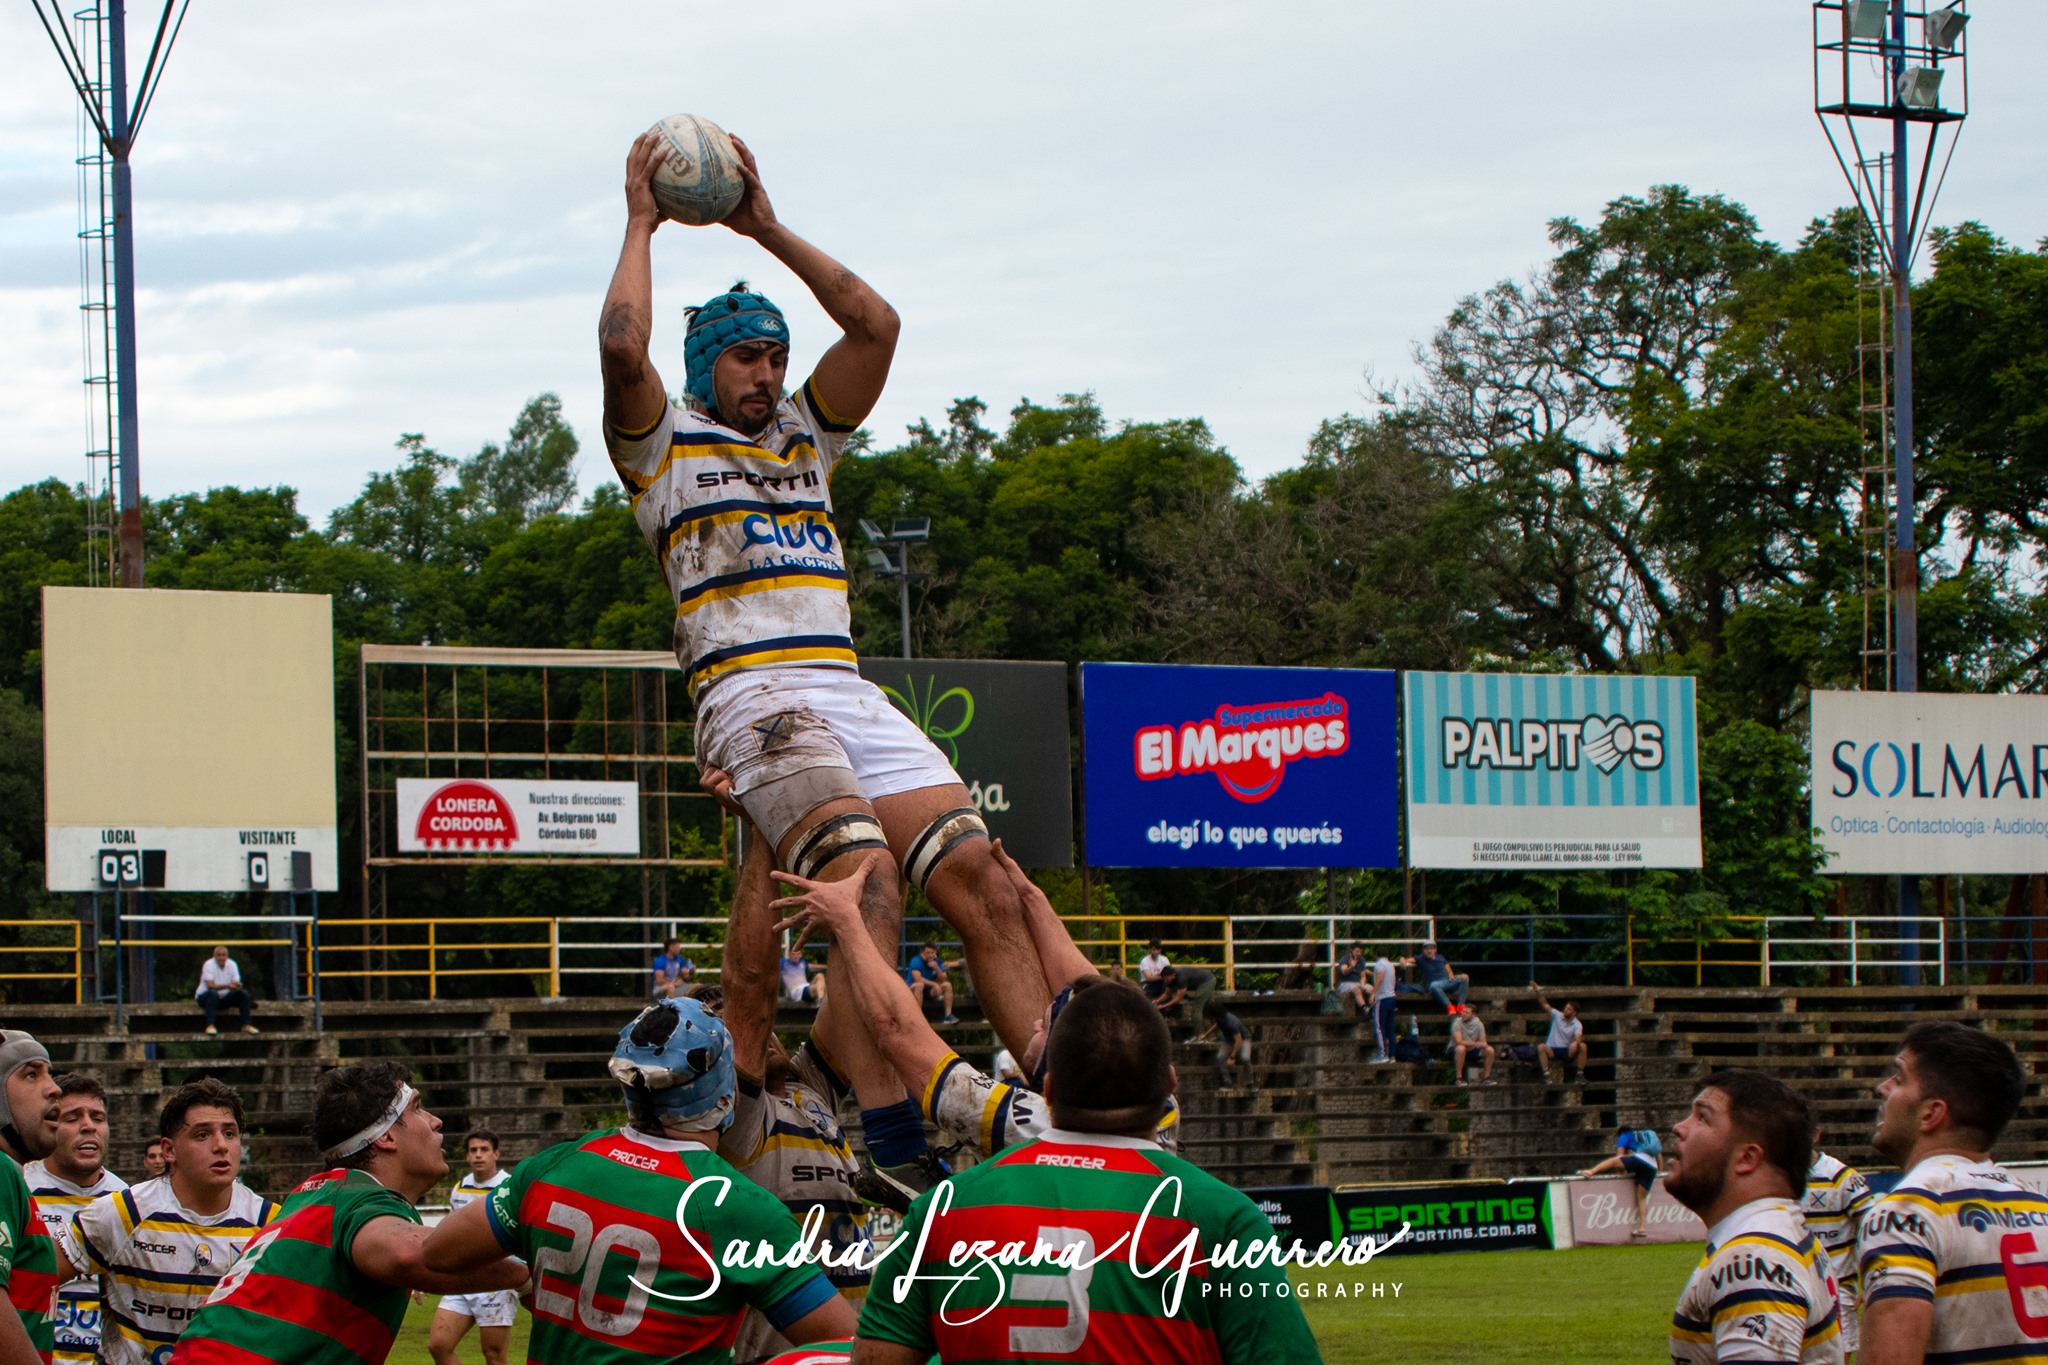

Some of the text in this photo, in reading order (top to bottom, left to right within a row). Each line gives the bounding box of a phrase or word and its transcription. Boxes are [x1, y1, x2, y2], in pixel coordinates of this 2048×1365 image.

[1220, 698, 1344, 729] Supermercado
[1140, 719, 1346, 774] El Marques
[436, 797, 498, 813] LONERA
[529, 792, 626, 806] Nuestras direcciones:
[430, 816, 504, 832] CORDOBA
[538, 811, 617, 825] Av. Belgrano 1440
[538, 827, 597, 840] Córdoba 660
[1148, 819, 1343, 850] elegí lo que querés
[1831, 816, 1879, 837] Optica
[1887, 816, 1985, 838] Contactología
[101, 829, 136, 844] LOCAL
[239, 831, 296, 846] VISITANTE
[1474, 842, 1642, 852] EL JUEGO COMPULSIVO ES PERJUDICIAL PARA LA SALUD
[1480, 853, 1509, 862] NECESITA
[1510, 853, 1532, 862] AYUDA
[1532, 853, 1553, 862] LLAME
[1615, 853, 1626, 862] LEY
[251, 856, 268, 884] 0
[608, 1148, 659, 1171] PROCER
[1035, 1153, 1106, 1170] PROCER
[1265, 1213, 1292, 1225] arios
[1347, 1197, 1536, 1231] SPORTING
[1350, 1223, 1538, 1246] WWSPORTING.COM.AR
[133, 1239, 176, 1255] PROCER
[532, 1200, 661, 1337] 20
[1009, 1225, 1096, 1353] 3
